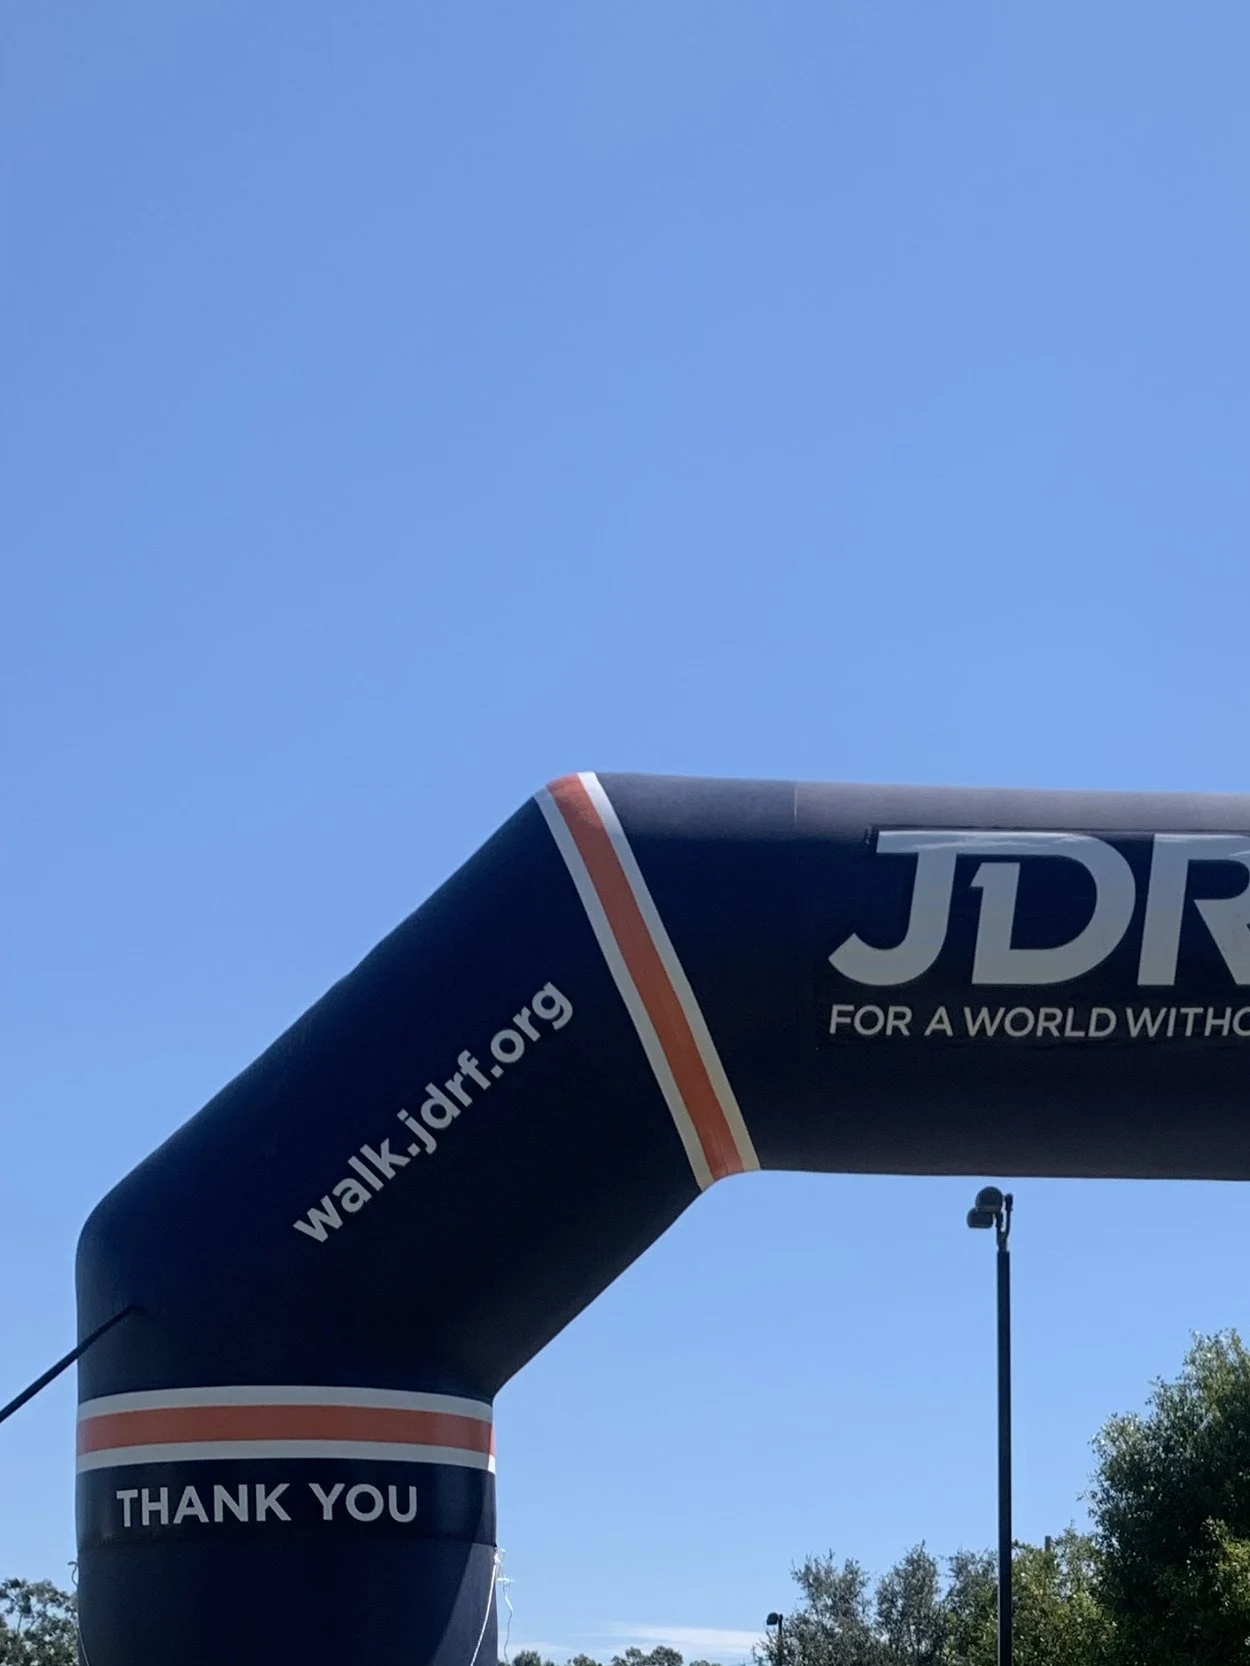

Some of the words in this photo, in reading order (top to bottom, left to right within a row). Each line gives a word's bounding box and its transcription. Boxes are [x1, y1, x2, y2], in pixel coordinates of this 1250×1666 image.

[829, 1005, 910, 1036] FOR
[924, 1006, 953, 1037] A
[963, 1007, 1117, 1038] WORLD
[292, 981, 574, 1243] walk.jdrf.org
[116, 1482, 292, 1527] THANK
[309, 1482, 417, 1524] YOU
